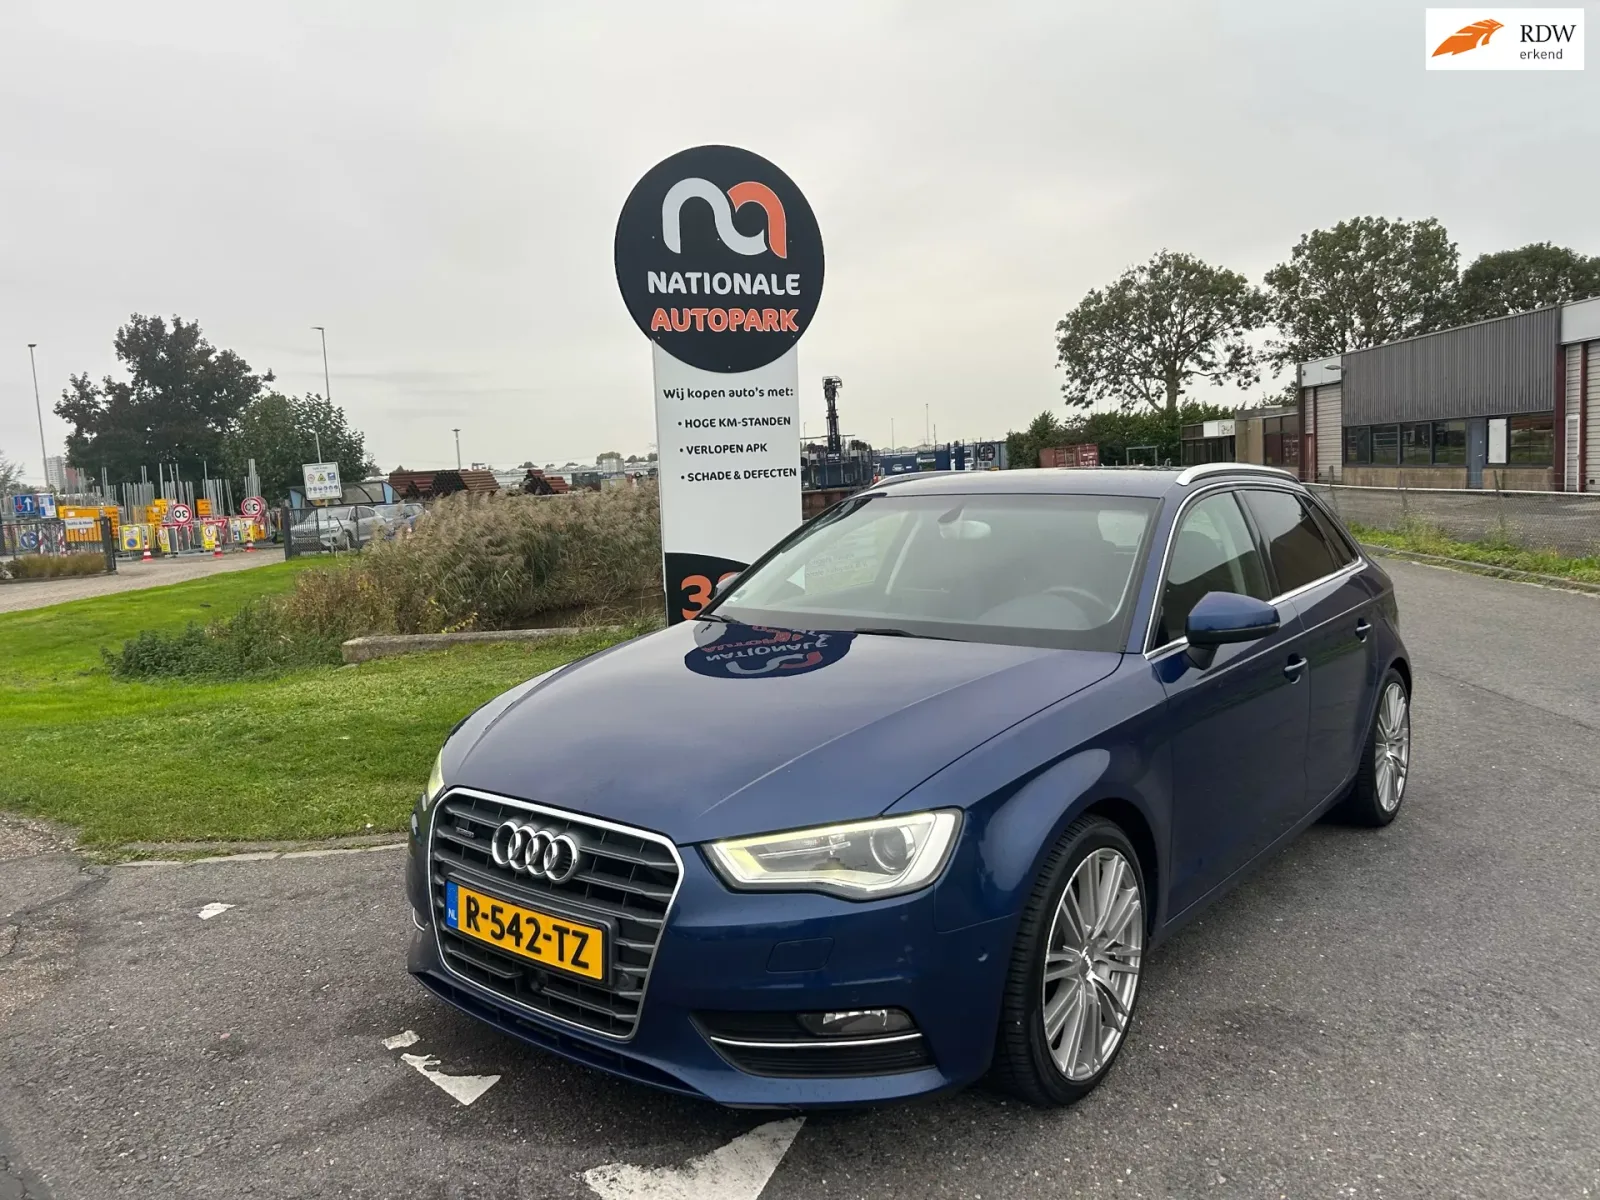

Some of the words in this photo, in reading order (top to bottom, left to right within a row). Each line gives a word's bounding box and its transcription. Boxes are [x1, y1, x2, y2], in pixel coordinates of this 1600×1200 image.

[647, 271, 801, 296] NATIONALE
[651, 307, 800, 333] AUTOPARK
[663, 388, 685, 401] Wij
[687, 388, 726, 400] kopen
[728, 387, 765, 398] auto's
[767, 387, 794, 397] met:
[684, 418, 716, 428] HOGE
[718, 416, 791, 428] KM-STANDEN
[686, 443, 744, 455] VERLOPEN
[745, 443, 768, 453] APK
[687, 471, 732, 482] SCHADE
[733, 471, 742, 480] &
[743, 468, 797, 480] DEFECTEN
[448, 907, 458, 921] NL
[465, 894, 590, 970] R-542-TZ
